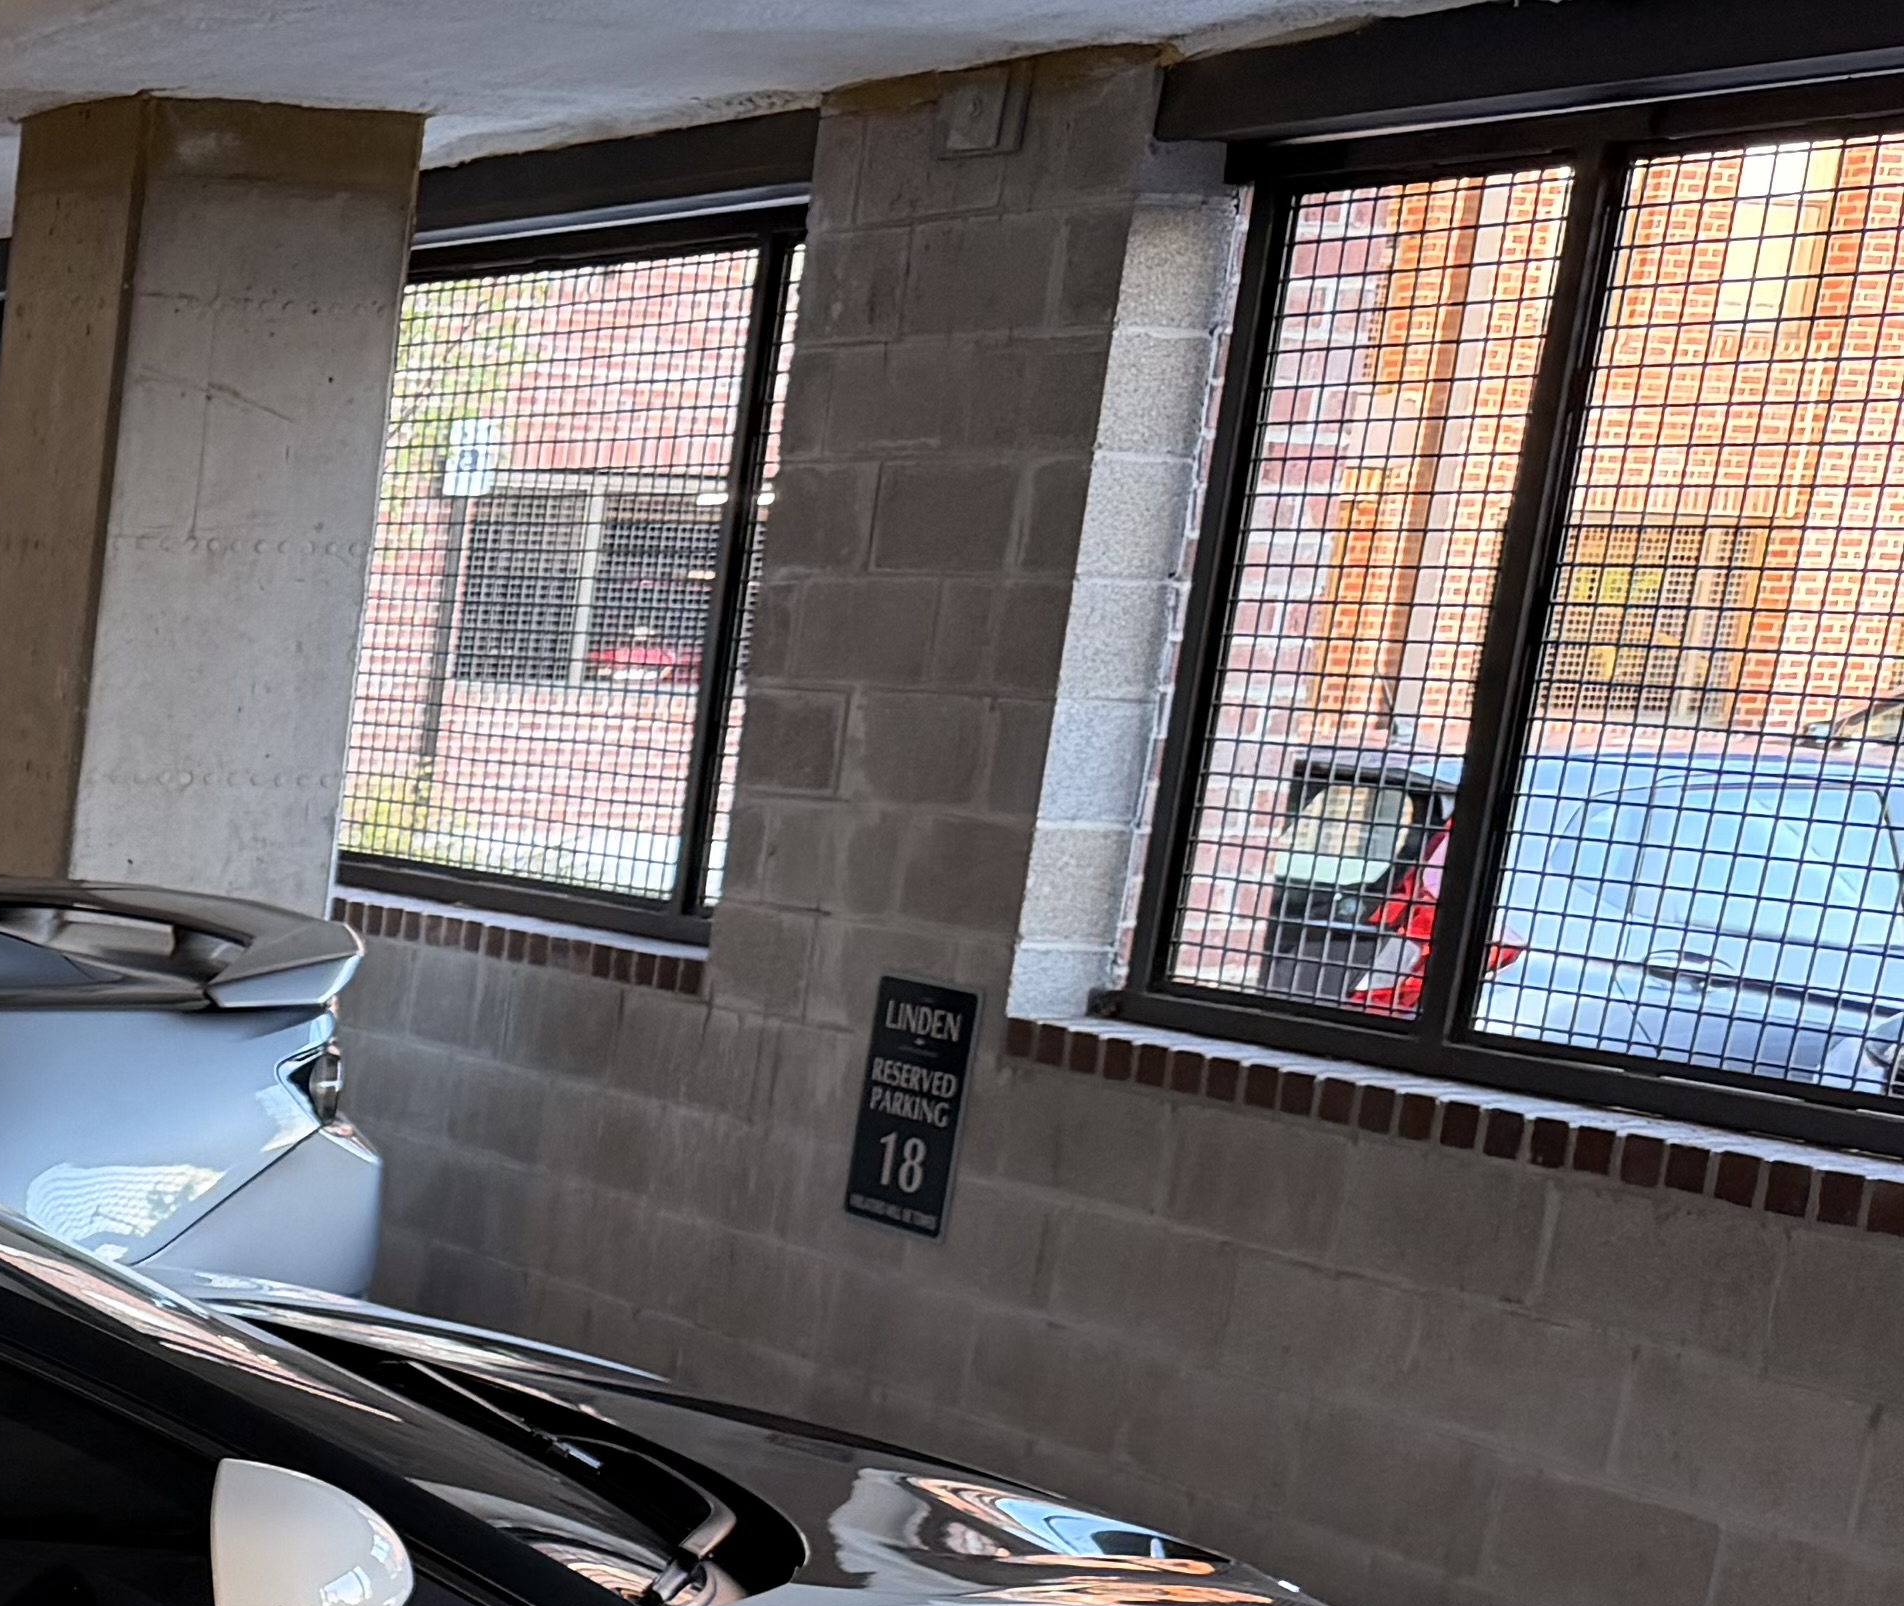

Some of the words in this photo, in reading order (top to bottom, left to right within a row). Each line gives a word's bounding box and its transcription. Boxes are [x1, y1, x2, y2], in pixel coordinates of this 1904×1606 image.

[885, 1000, 963, 1042] LINDEN
[872, 1057, 958, 1098] RESERVED
[869, 1086, 950, 1127] PARKING
[880, 1131, 927, 1193] 18
